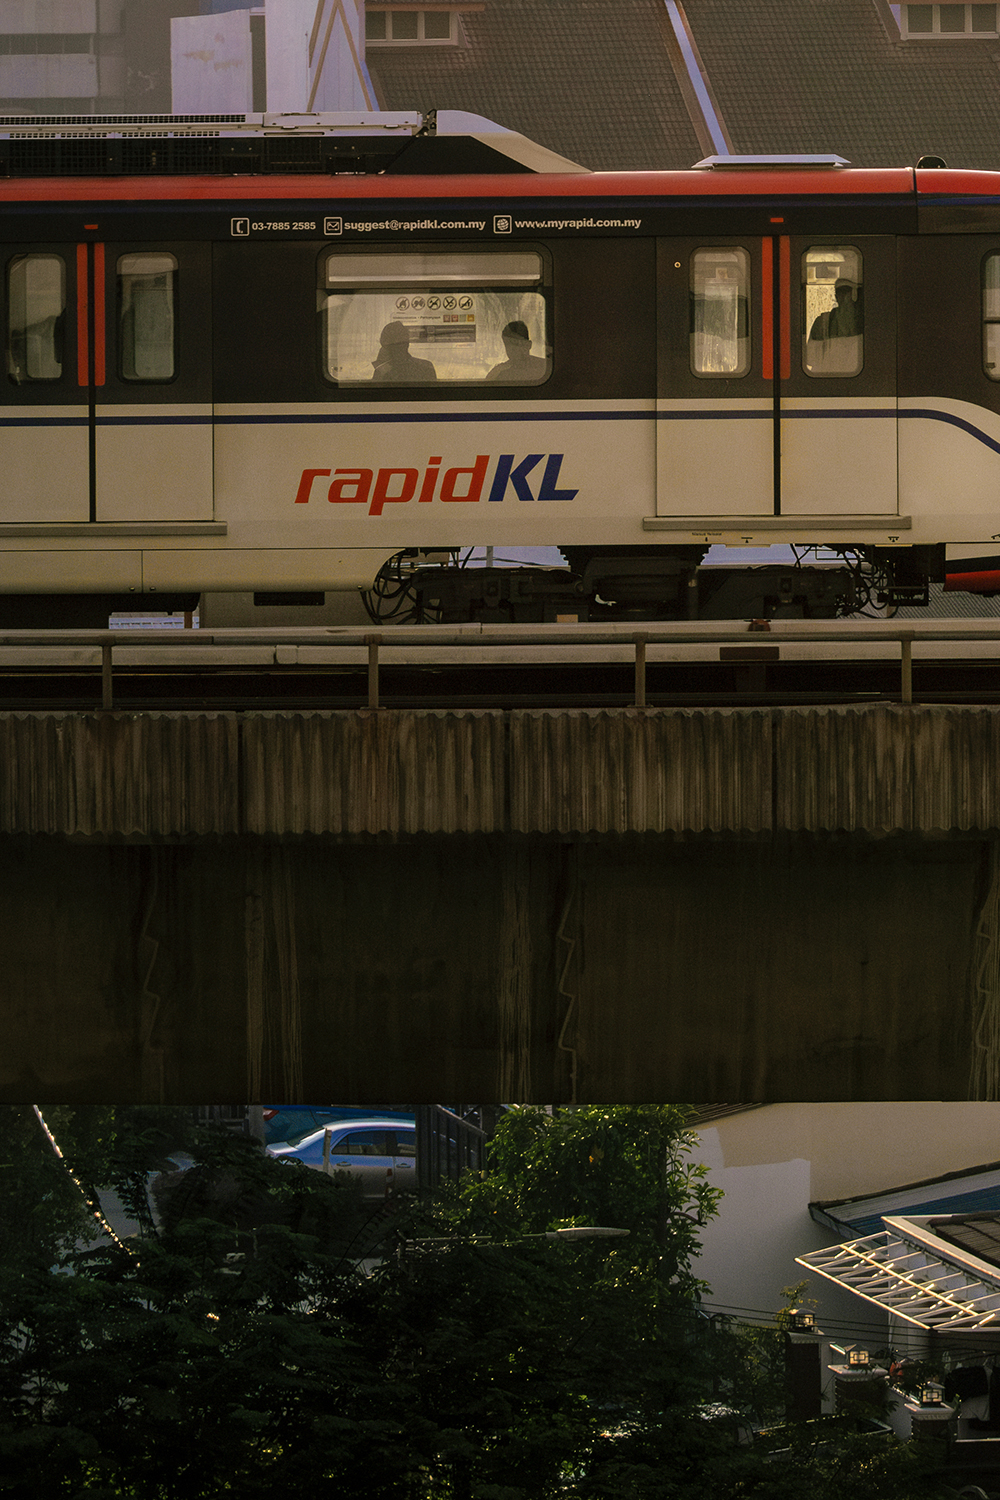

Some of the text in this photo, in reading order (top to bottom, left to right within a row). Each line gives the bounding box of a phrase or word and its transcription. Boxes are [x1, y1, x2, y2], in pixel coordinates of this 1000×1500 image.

[252, 222, 316, 231] 03-7885 2585
[344, 220, 486, 232] suggest@rapidkl.com.my
[515, 218, 641, 230] www.myrapid.com.my
[294, 453, 580, 516] rapidKL
